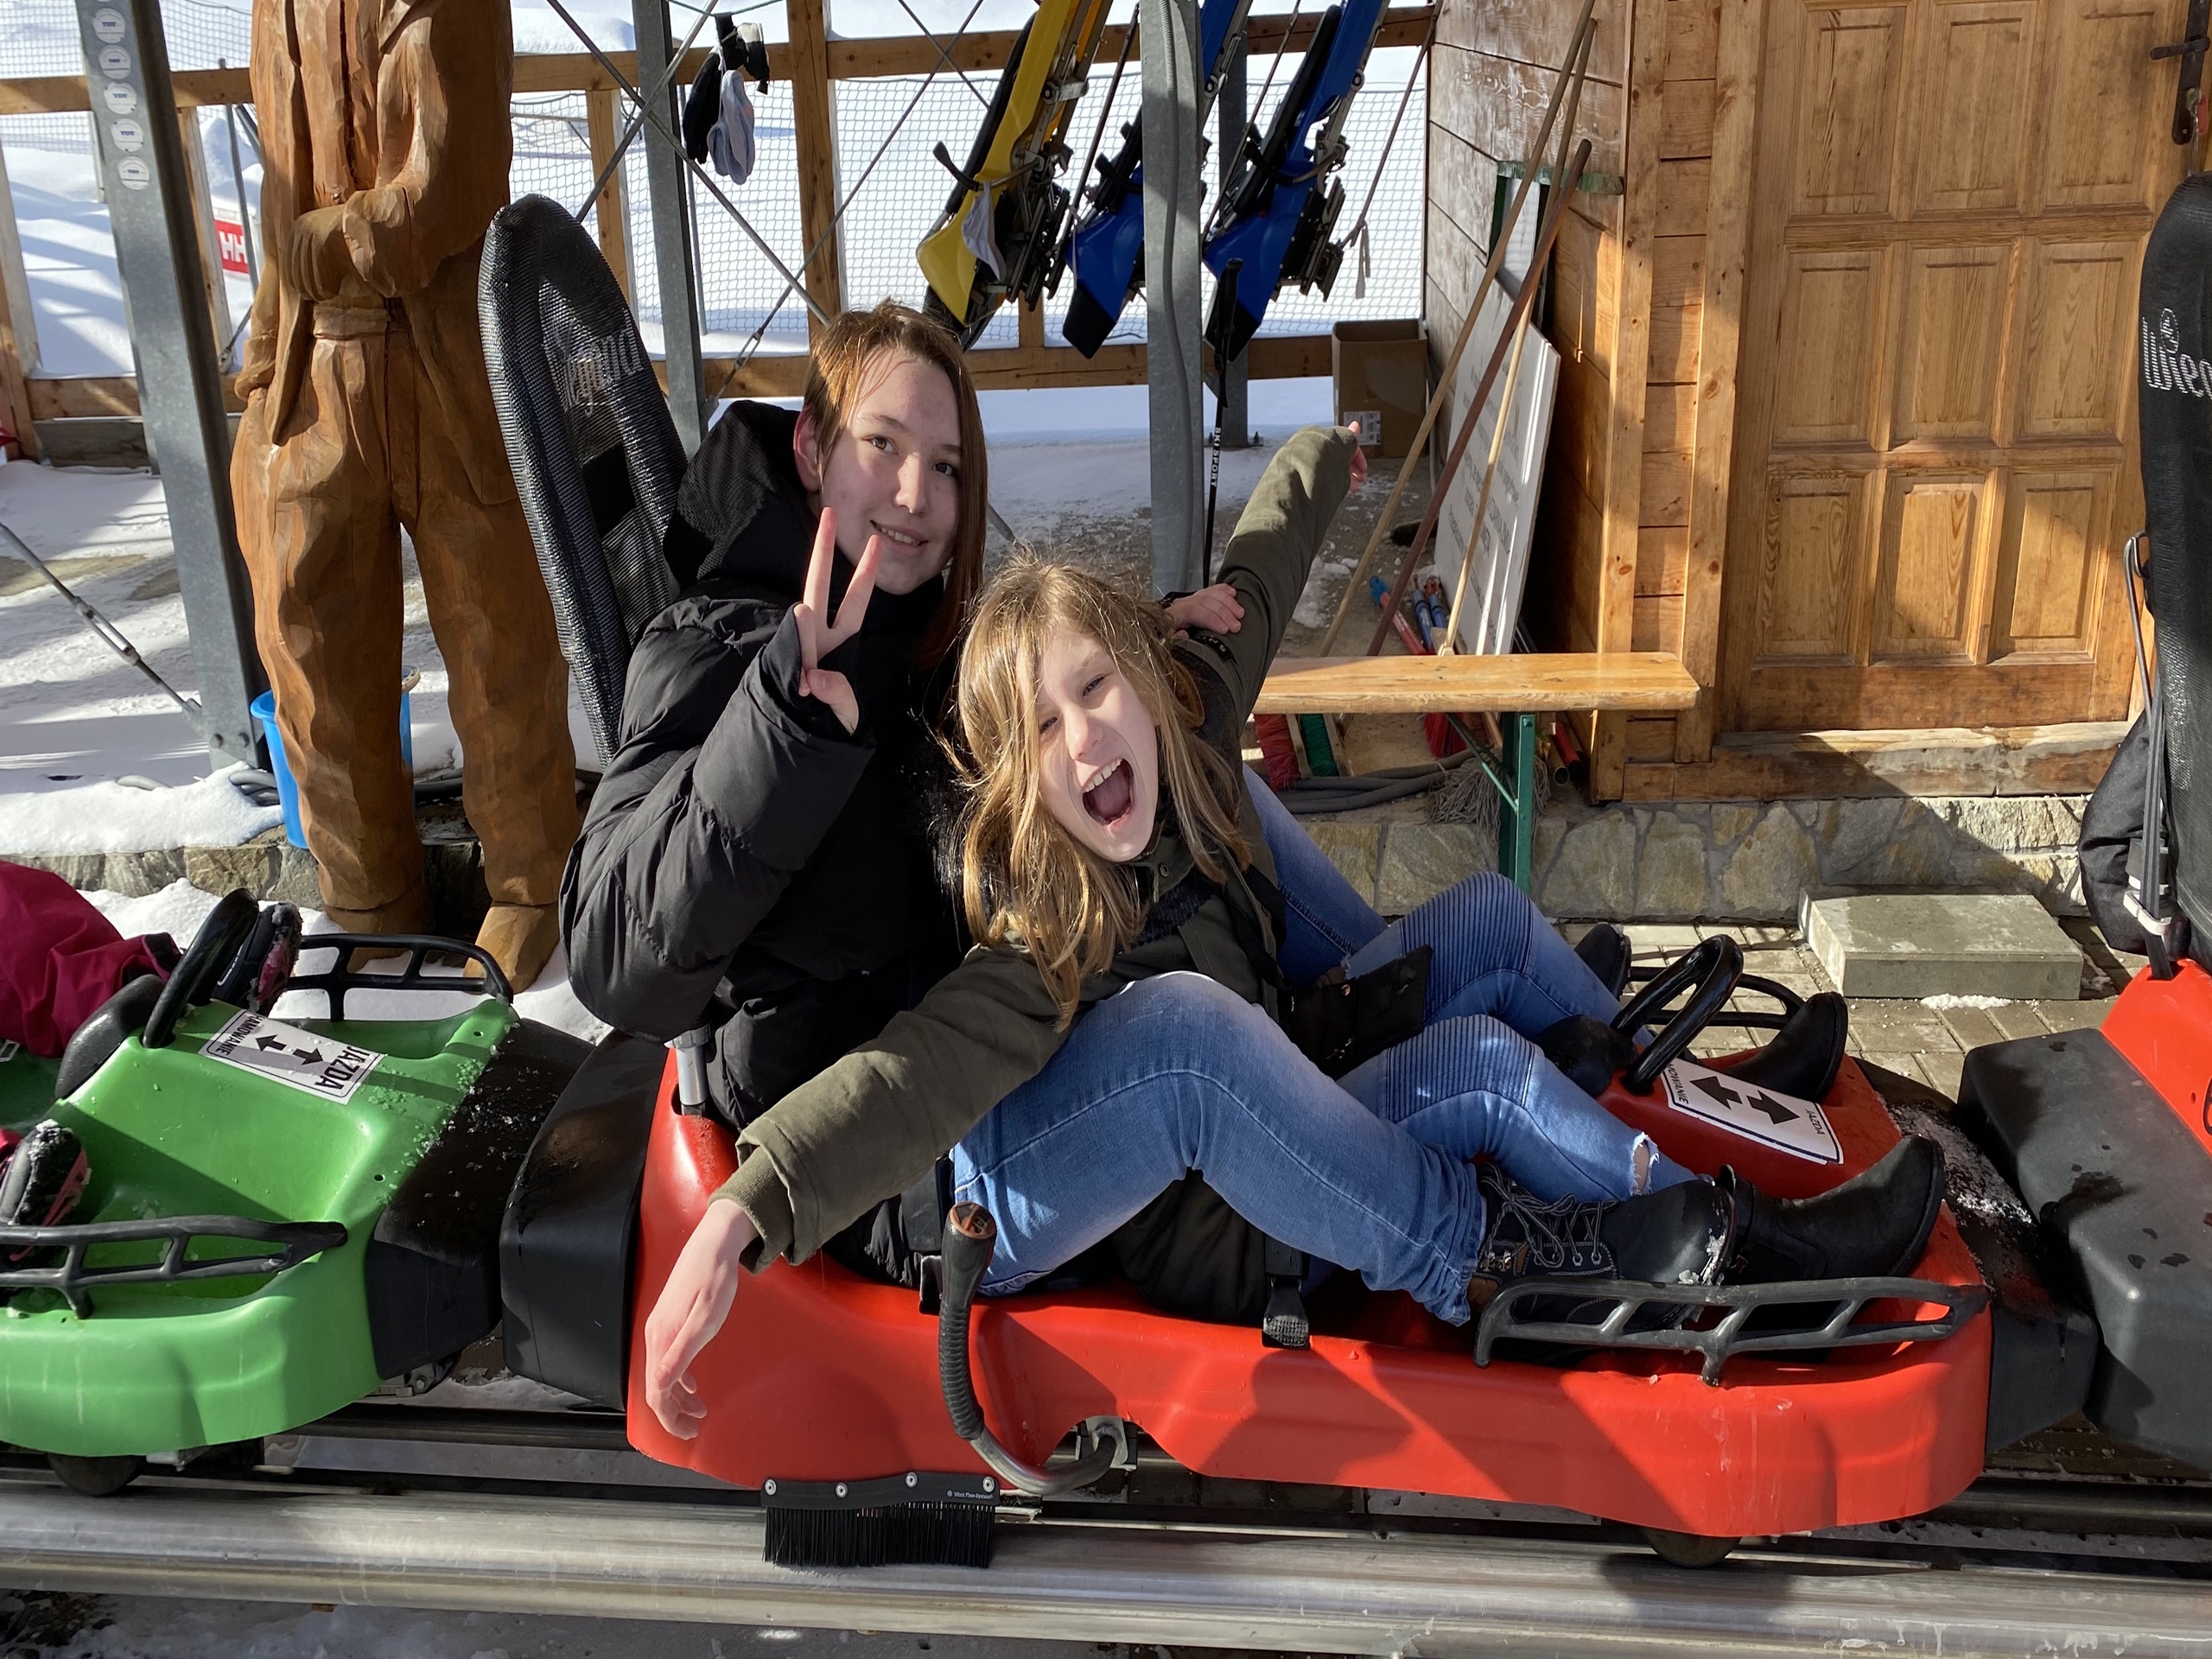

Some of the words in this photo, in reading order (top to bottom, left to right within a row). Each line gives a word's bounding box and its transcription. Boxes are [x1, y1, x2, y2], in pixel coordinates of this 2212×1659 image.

[219, 231, 248, 264] HH
[1211, 450, 1219, 487] SPORT
[215, 1014, 265, 1055] HAMOWANIE
[315, 1046, 370, 1090] JAZDA
[1668, 1064, 1689, 1104] MOWANIE
[1805, 1109, 1826, 1135] JAZDA
